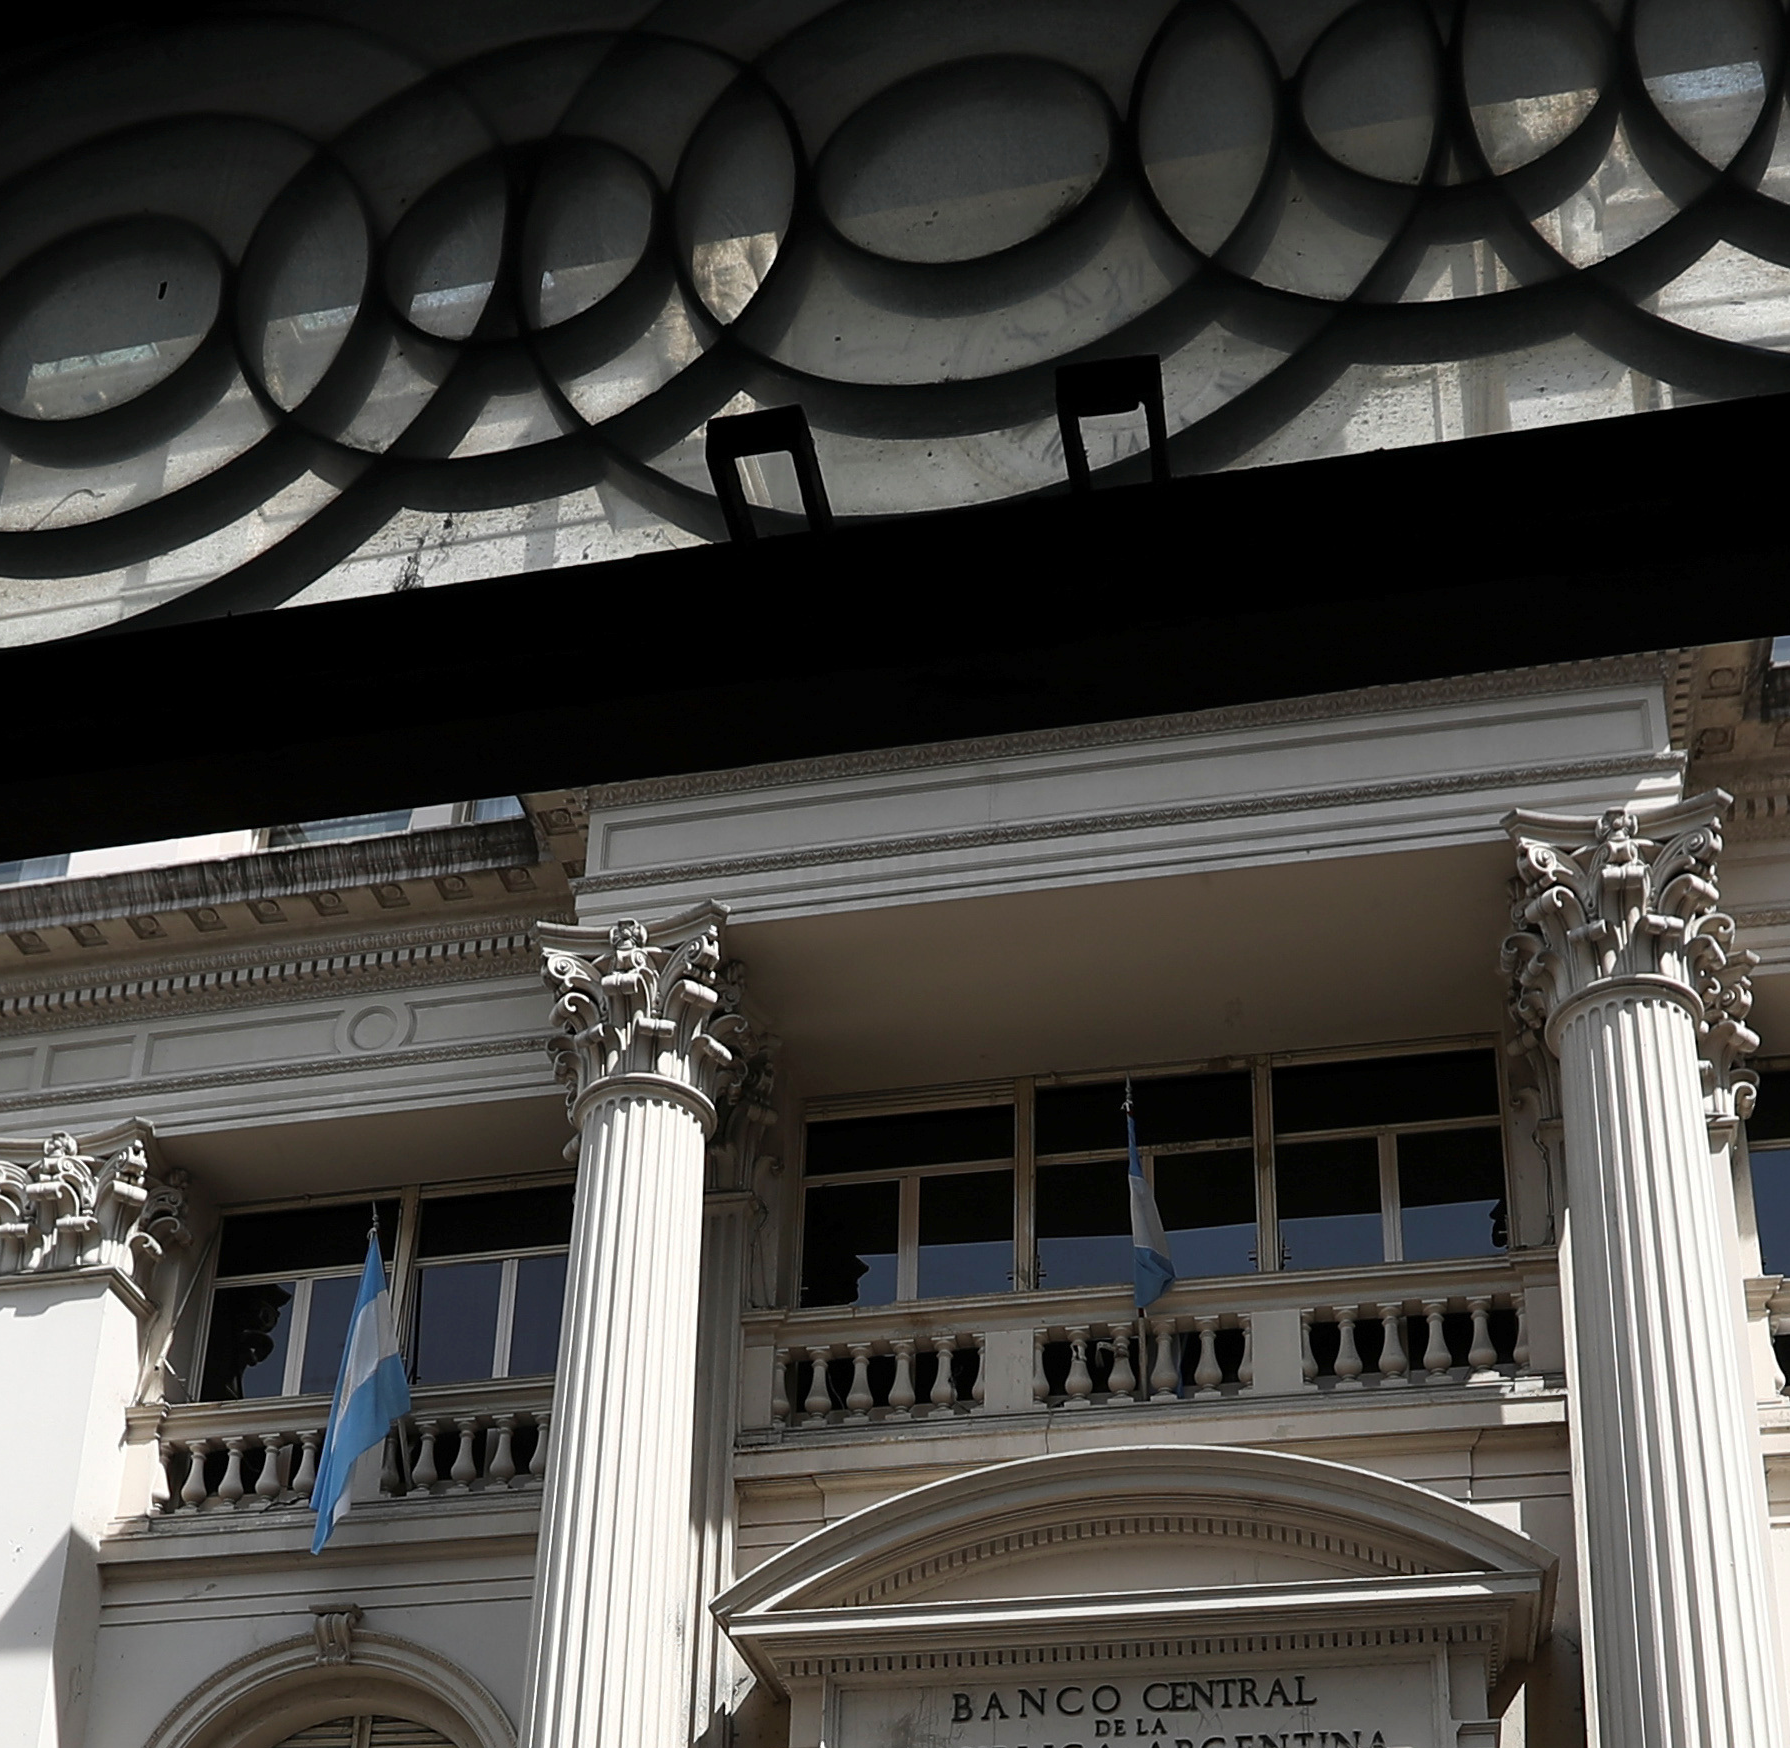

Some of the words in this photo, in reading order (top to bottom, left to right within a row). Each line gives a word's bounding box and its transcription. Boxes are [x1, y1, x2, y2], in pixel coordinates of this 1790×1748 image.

[952, 1685, 1121, 1722] BANCO
[1142, 1676, 1318, 1712] CENTRAL
[1095, 1719, 1126, 1737] DE
[1136, 1718, 1168, 1736] LA
